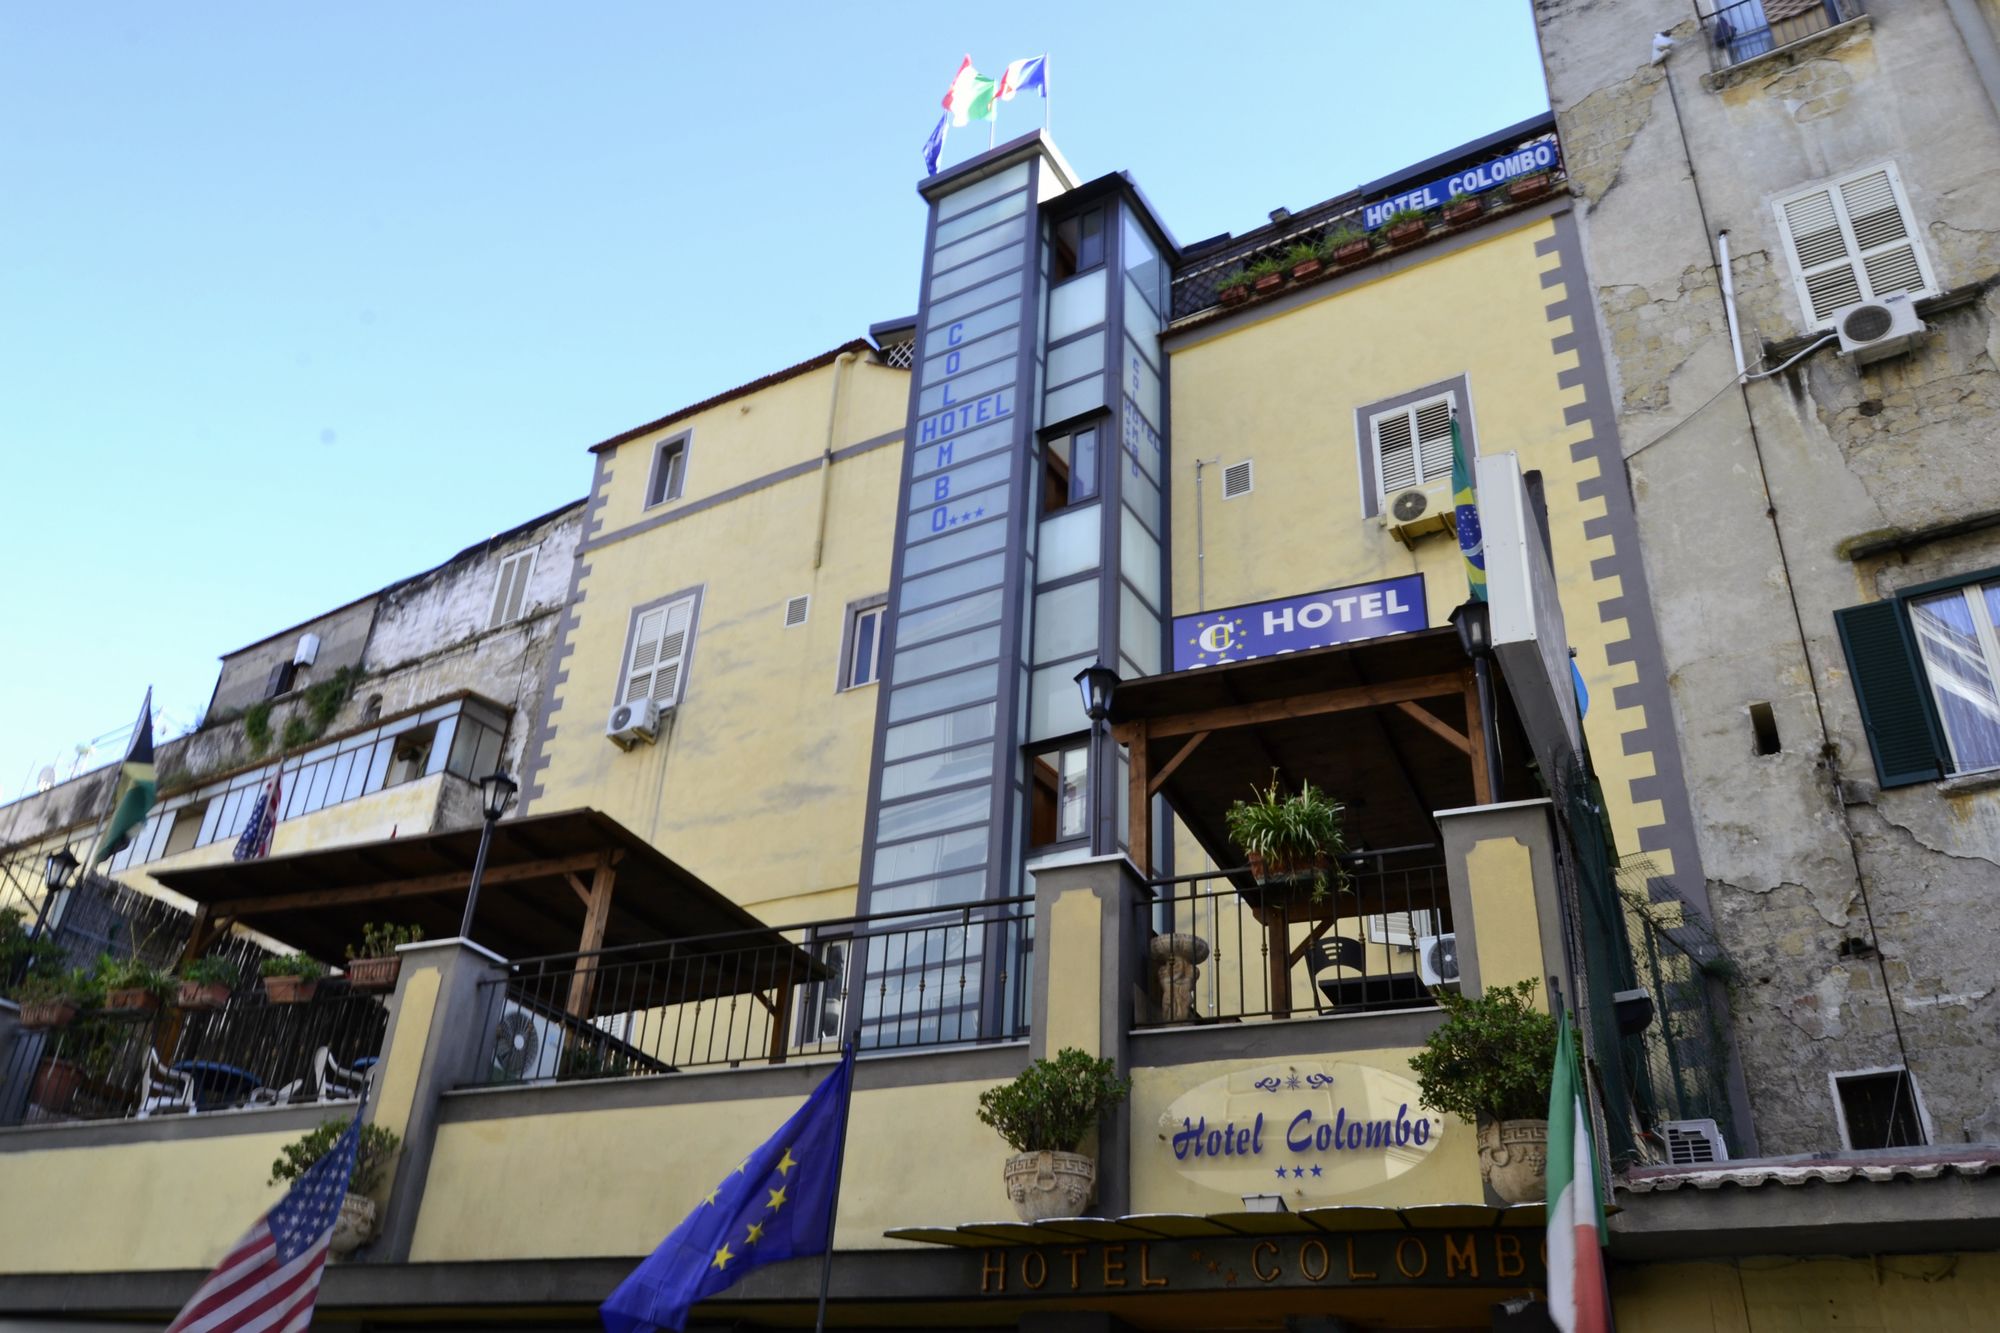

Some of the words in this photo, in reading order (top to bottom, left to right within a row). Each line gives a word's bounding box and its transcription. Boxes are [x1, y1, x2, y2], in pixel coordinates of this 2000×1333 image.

[1366, 188, 1439, 227] HOTEL
[1448, 145, 1550, 196] COLOMBO
[921, 394, 1010, 443] HOTEL
[932, 322, 964, 533] COLOMBO
[1263, 589, 1409, 636] HOTEL
[1172, 1112, 1264, 1160] Hotel
[1286, 1103, 1431, 1153] Colombo
[981, 1244, 1168, 1292] HOTEL
[1251, 1233, 1547, 1283] COLOMB
